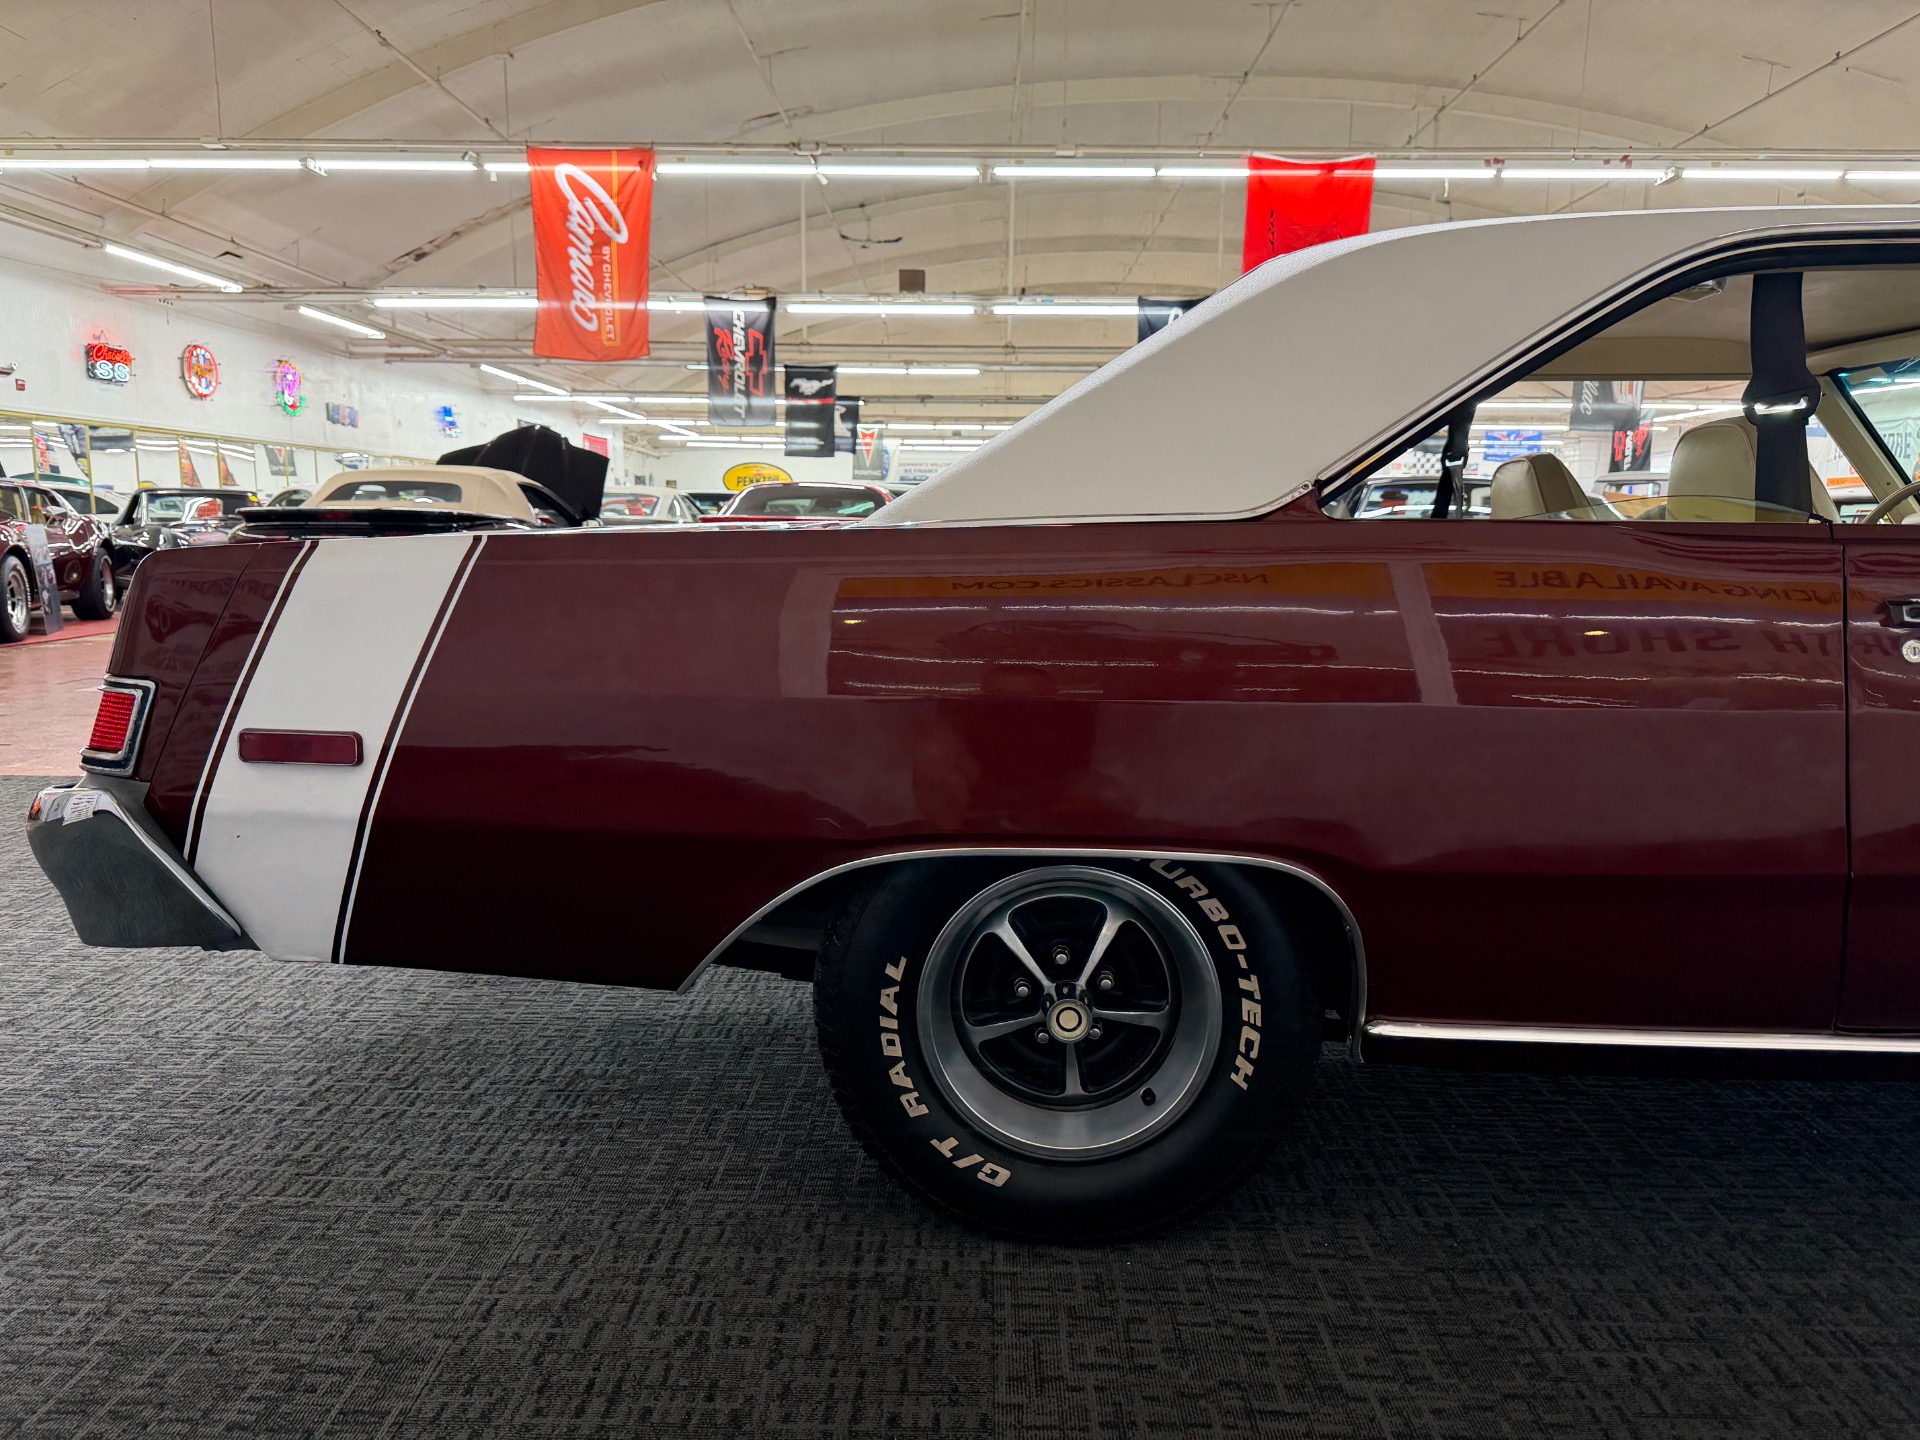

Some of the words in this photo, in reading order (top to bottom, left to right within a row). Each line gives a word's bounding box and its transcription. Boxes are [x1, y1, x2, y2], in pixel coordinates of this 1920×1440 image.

[554, 162, 630, 332] Camaro
[602, 245, 612, 262] BY
[95, 359, 131, 382] SS
[733, 309, 747, 419] CHEVROLET
[1131, 857, 1263, 1091] URBO-TECH
[879, 955, 930, 1119] RADIAL
[929, 1136, 1012, 1188] G/T
